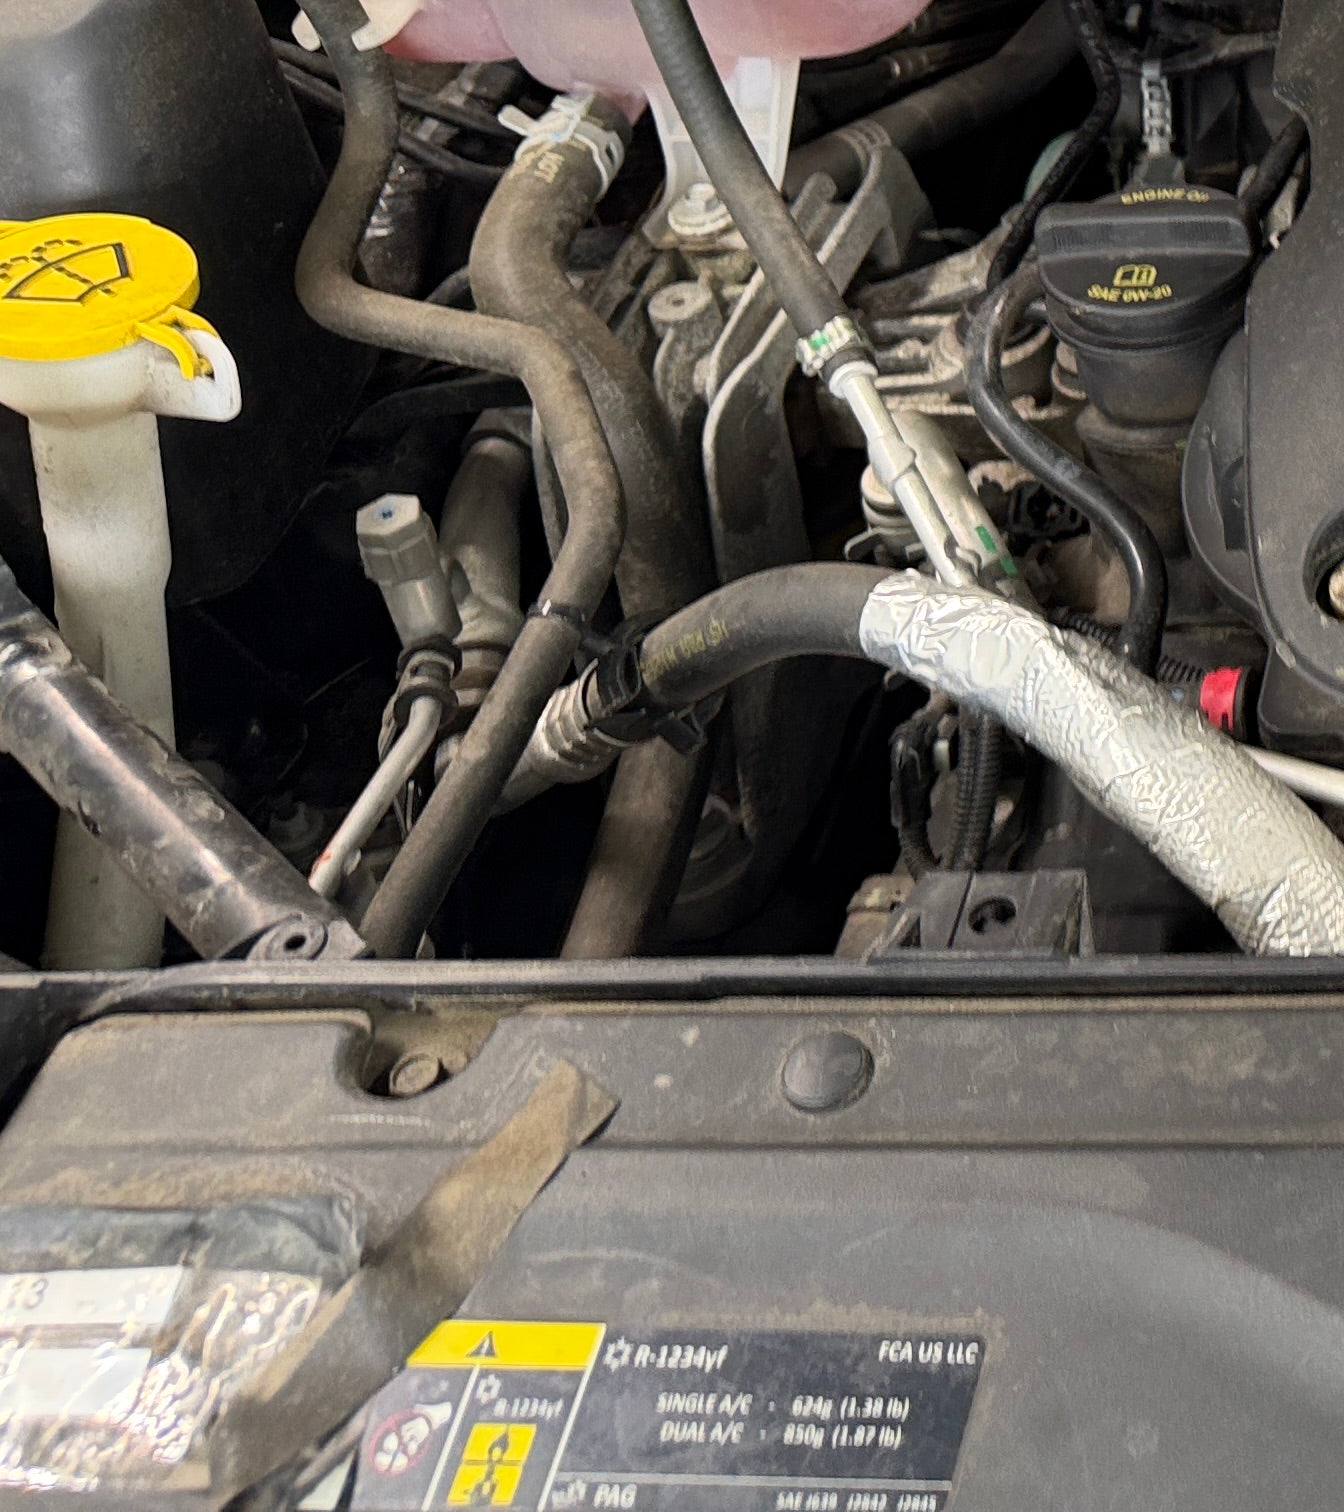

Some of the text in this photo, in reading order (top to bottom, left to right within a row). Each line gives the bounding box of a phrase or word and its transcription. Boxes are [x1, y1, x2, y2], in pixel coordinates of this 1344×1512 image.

[1121, 187, 1186, 206] ENGINE
[1087, 283, 1121, 303] SAE
[634, 1343, 729, 1374] R-1234yf
[878, 1340, 979, 1365] FCA US LLC
[656, 1391, 718, 1415] SINGLE
[718, 1391, 753, 1418] A/C
[886, 1395, 910, 1423] lb)
[660, 1419, 706, 1444] DUAL
[708, 1419, 745, 1446] A/C
[878, 1423, 903, 1451] lb)
[593, 1482, 638, 1510] PAG
